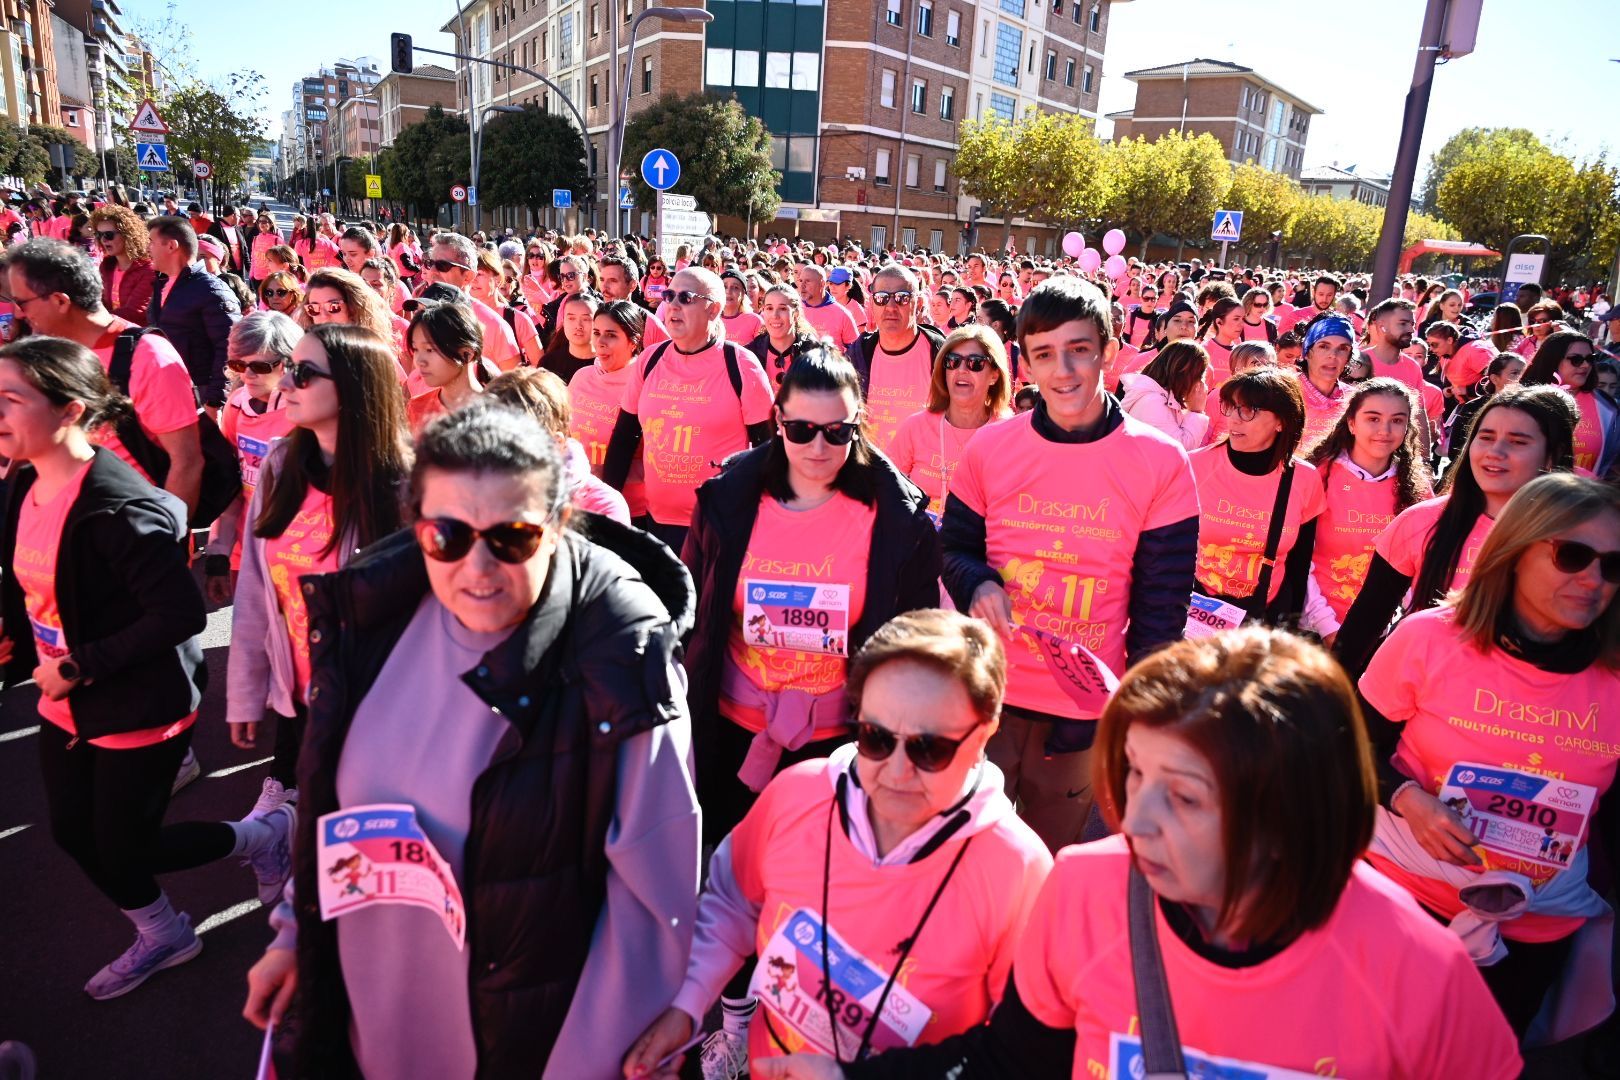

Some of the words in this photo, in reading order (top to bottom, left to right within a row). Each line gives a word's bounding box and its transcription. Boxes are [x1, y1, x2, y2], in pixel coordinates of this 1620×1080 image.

[1071, 525, 1121, 539] CAROBELS
[1231, 537, 1265, 549] SUZUKI
[276, 551, 313, 564] SUZUKI
[1034, 549, 1079, 562] SUZUKI
[782, 608, 830, 628] 1890
[1034, 612, 1106, 637] Carrera
[1188, 608, 1227, 630] 2908
[769, 655, 840, 673] Carrera
[1554, 735, 1620, 756] CAROBELS
[1457, 769, 1475, 785] hp
[1487, 794, 1558, 828] 2910
